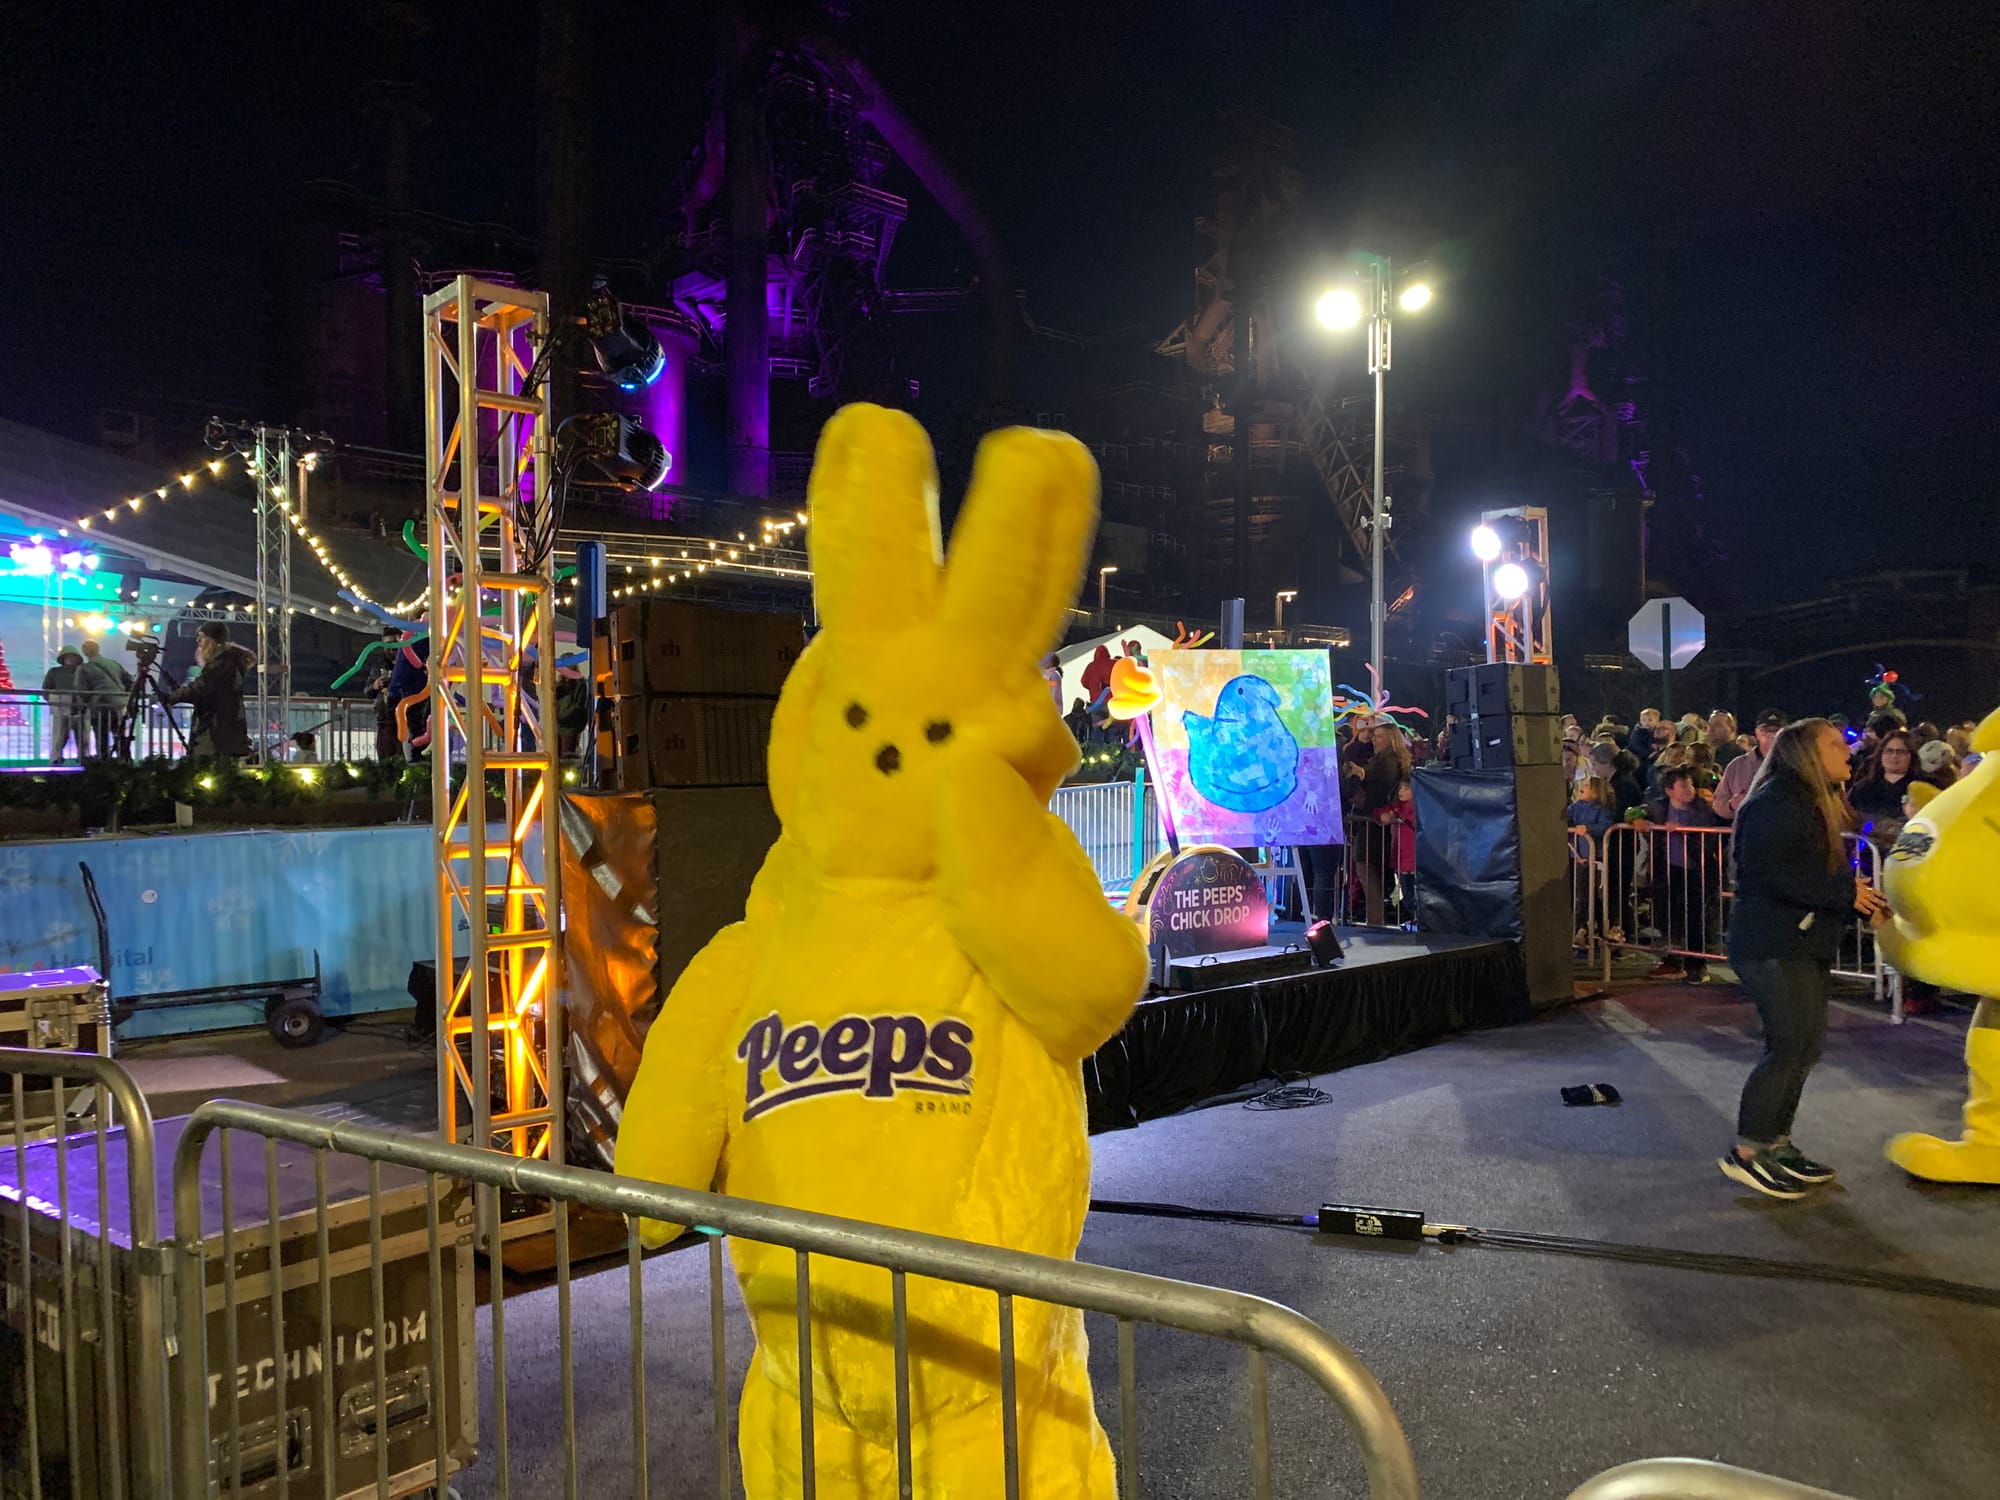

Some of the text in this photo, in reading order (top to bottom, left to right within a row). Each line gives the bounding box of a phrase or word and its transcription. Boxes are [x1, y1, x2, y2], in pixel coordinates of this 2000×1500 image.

[1174, 889, 1200, 909] THE
[1170, 905, 1250, 931] CHICK DROP
[737, 1011, 974, 1105] Peeps
[915, 1101, 972, 1115] BRAND
